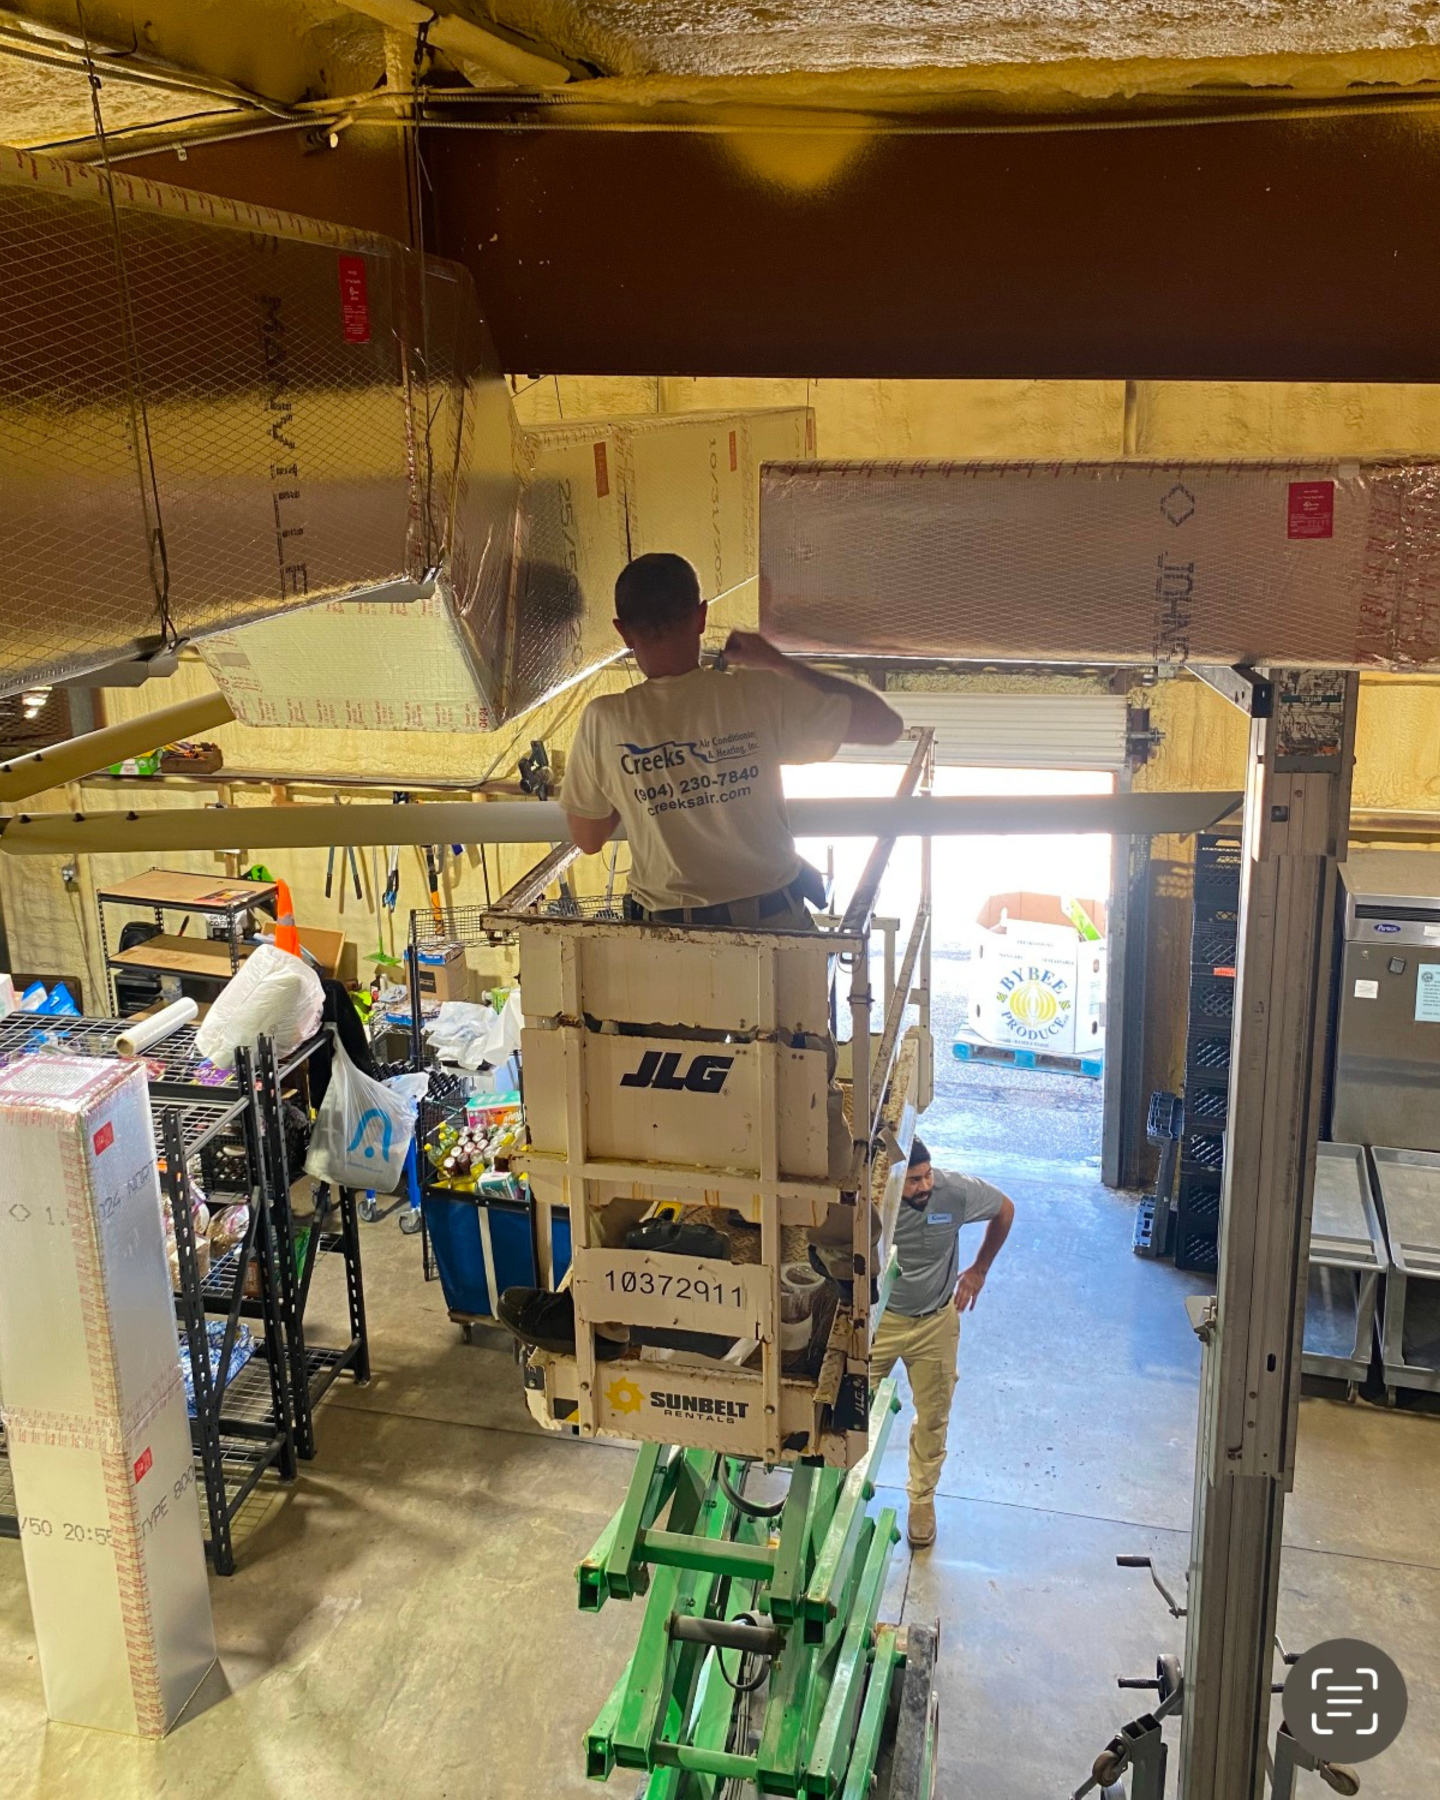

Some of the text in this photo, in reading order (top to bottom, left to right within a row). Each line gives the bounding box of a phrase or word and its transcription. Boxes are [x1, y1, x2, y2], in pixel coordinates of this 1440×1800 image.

[700, 739, 710, 747] Air
[620, 747, 686, 775] Creeks
[634, 765, 759, 804] (904) 230-7840
[647, 786, 751, 816] creeksair.com
[1000, 966, 1068, 995] BYBEE
[1001, 1010, 1067, 1041] PRODUCE
[620, 1050, 735, 1093] JLG
[605, 1270, 741, 1307] 10372911
[650, 1391, 749, 1419] SUNBELT
[664, 1410, 735, 1424] RENTALS
[140, 1495, 169, 1539] TYPE
